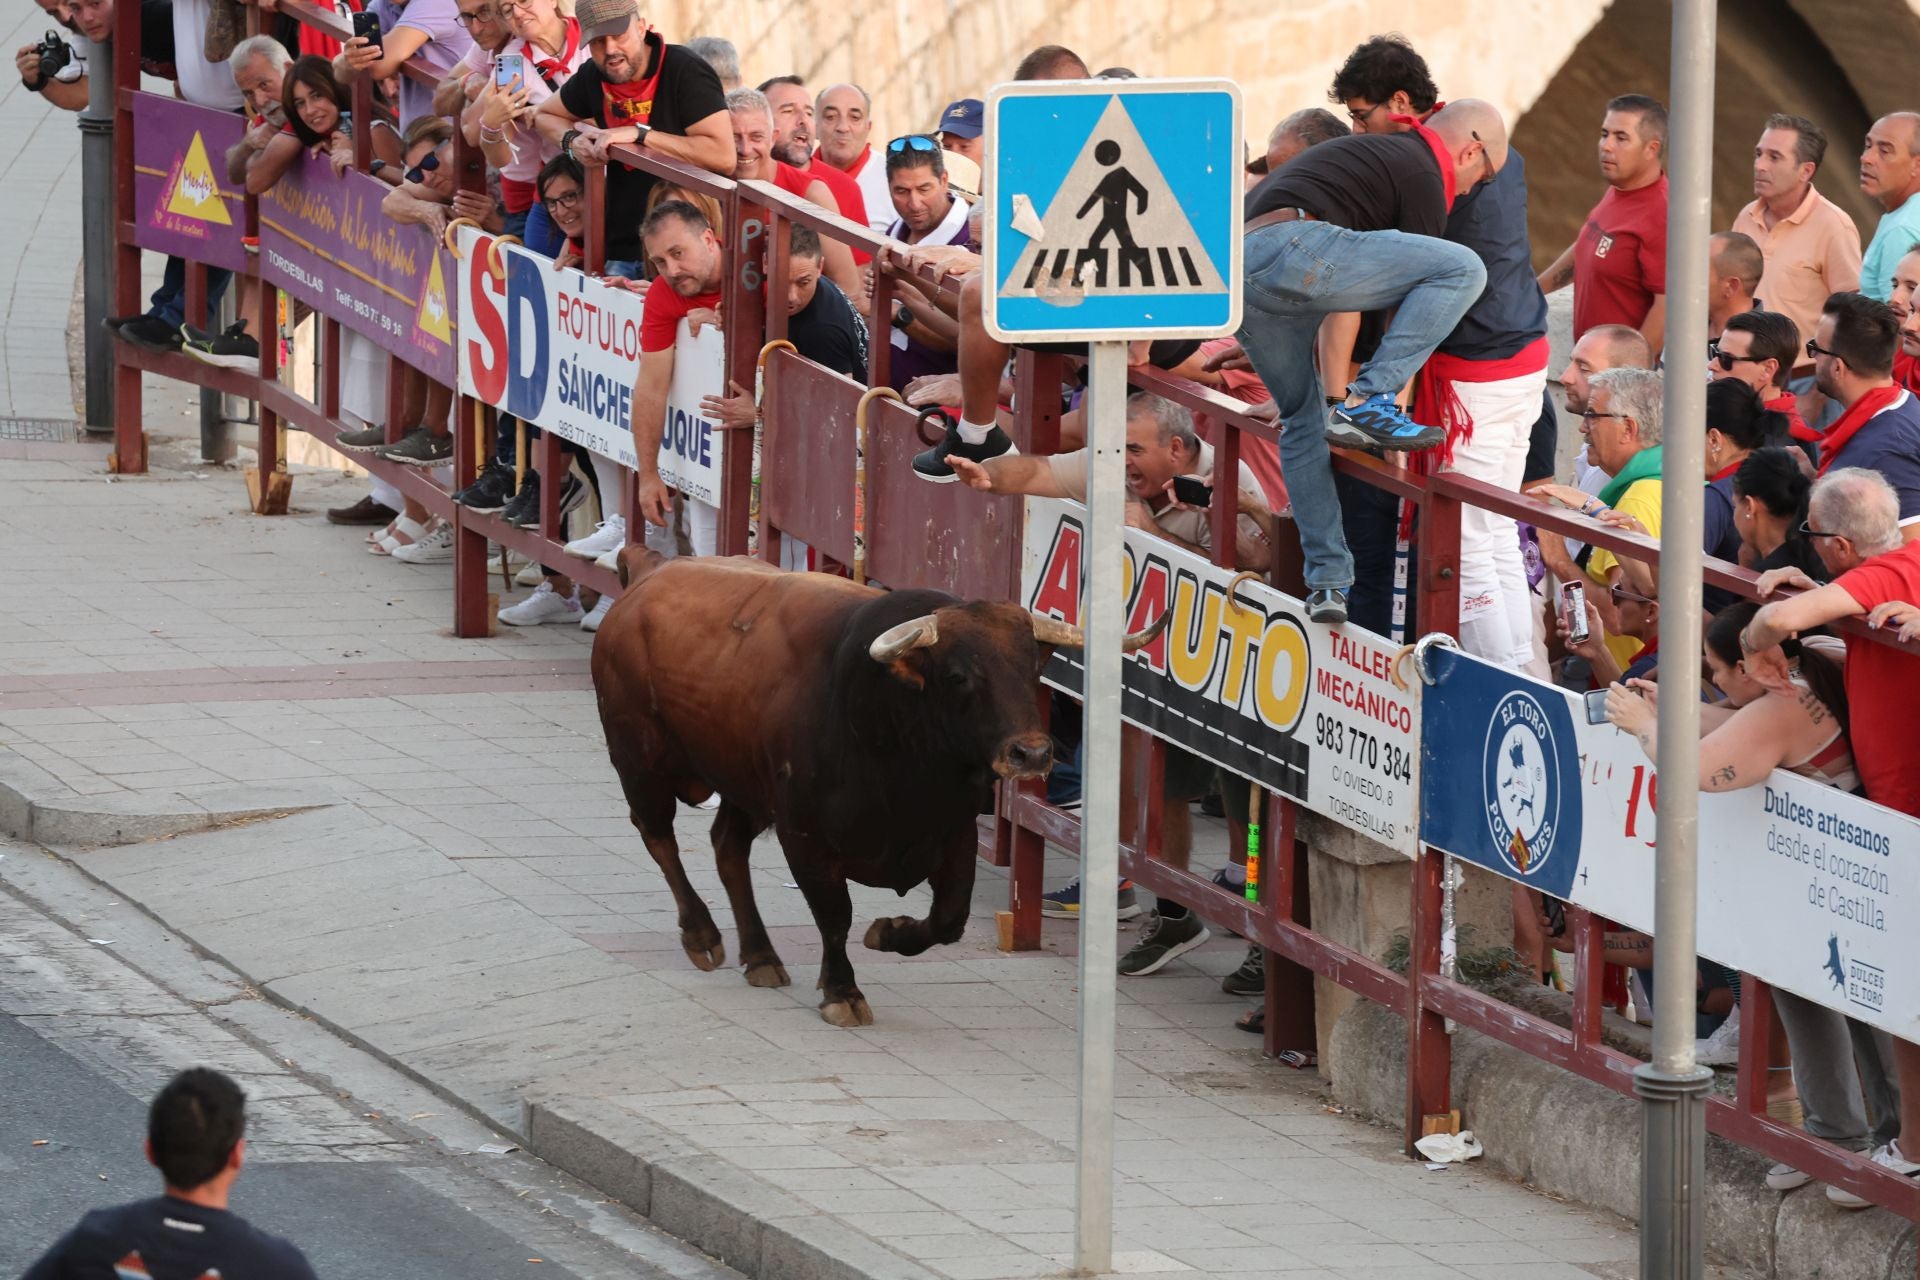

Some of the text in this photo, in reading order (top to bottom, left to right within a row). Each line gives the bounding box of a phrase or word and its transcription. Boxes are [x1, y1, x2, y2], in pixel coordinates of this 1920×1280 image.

[268, 249, 324, 293] TORDESILLAS
[558, 353, 712, 469] SÁNCHE UQUE
[558, 420, 573, 440] 983
[575, 427, 585, 443] 77
[587, 433, 597, 450] 06
[599, 438, 609, 454] 74
[1317, 667, 1411, 734] MECÁNICO
[1501, 700, 1546, 740] EL TORO
[1316, 712, 1411, 785] 983 770 384
[1332, 765, 1342, 783] C/
[1388, 790, 1393, 806] 8
[1329, 795, 1395, 840] TORDESILLAS
[1489, 800, 1552, 865] POLVONES
[1764, 786, 1890, 857] Dulces artesanos
[1767, 824, 1889, 894] desde el corazón
[1808, 877, 1888, 932] de Castilla.
[1850, 965, 1885, 989] DULCES
[1850, 982, 1883, 1006] EL TORO
